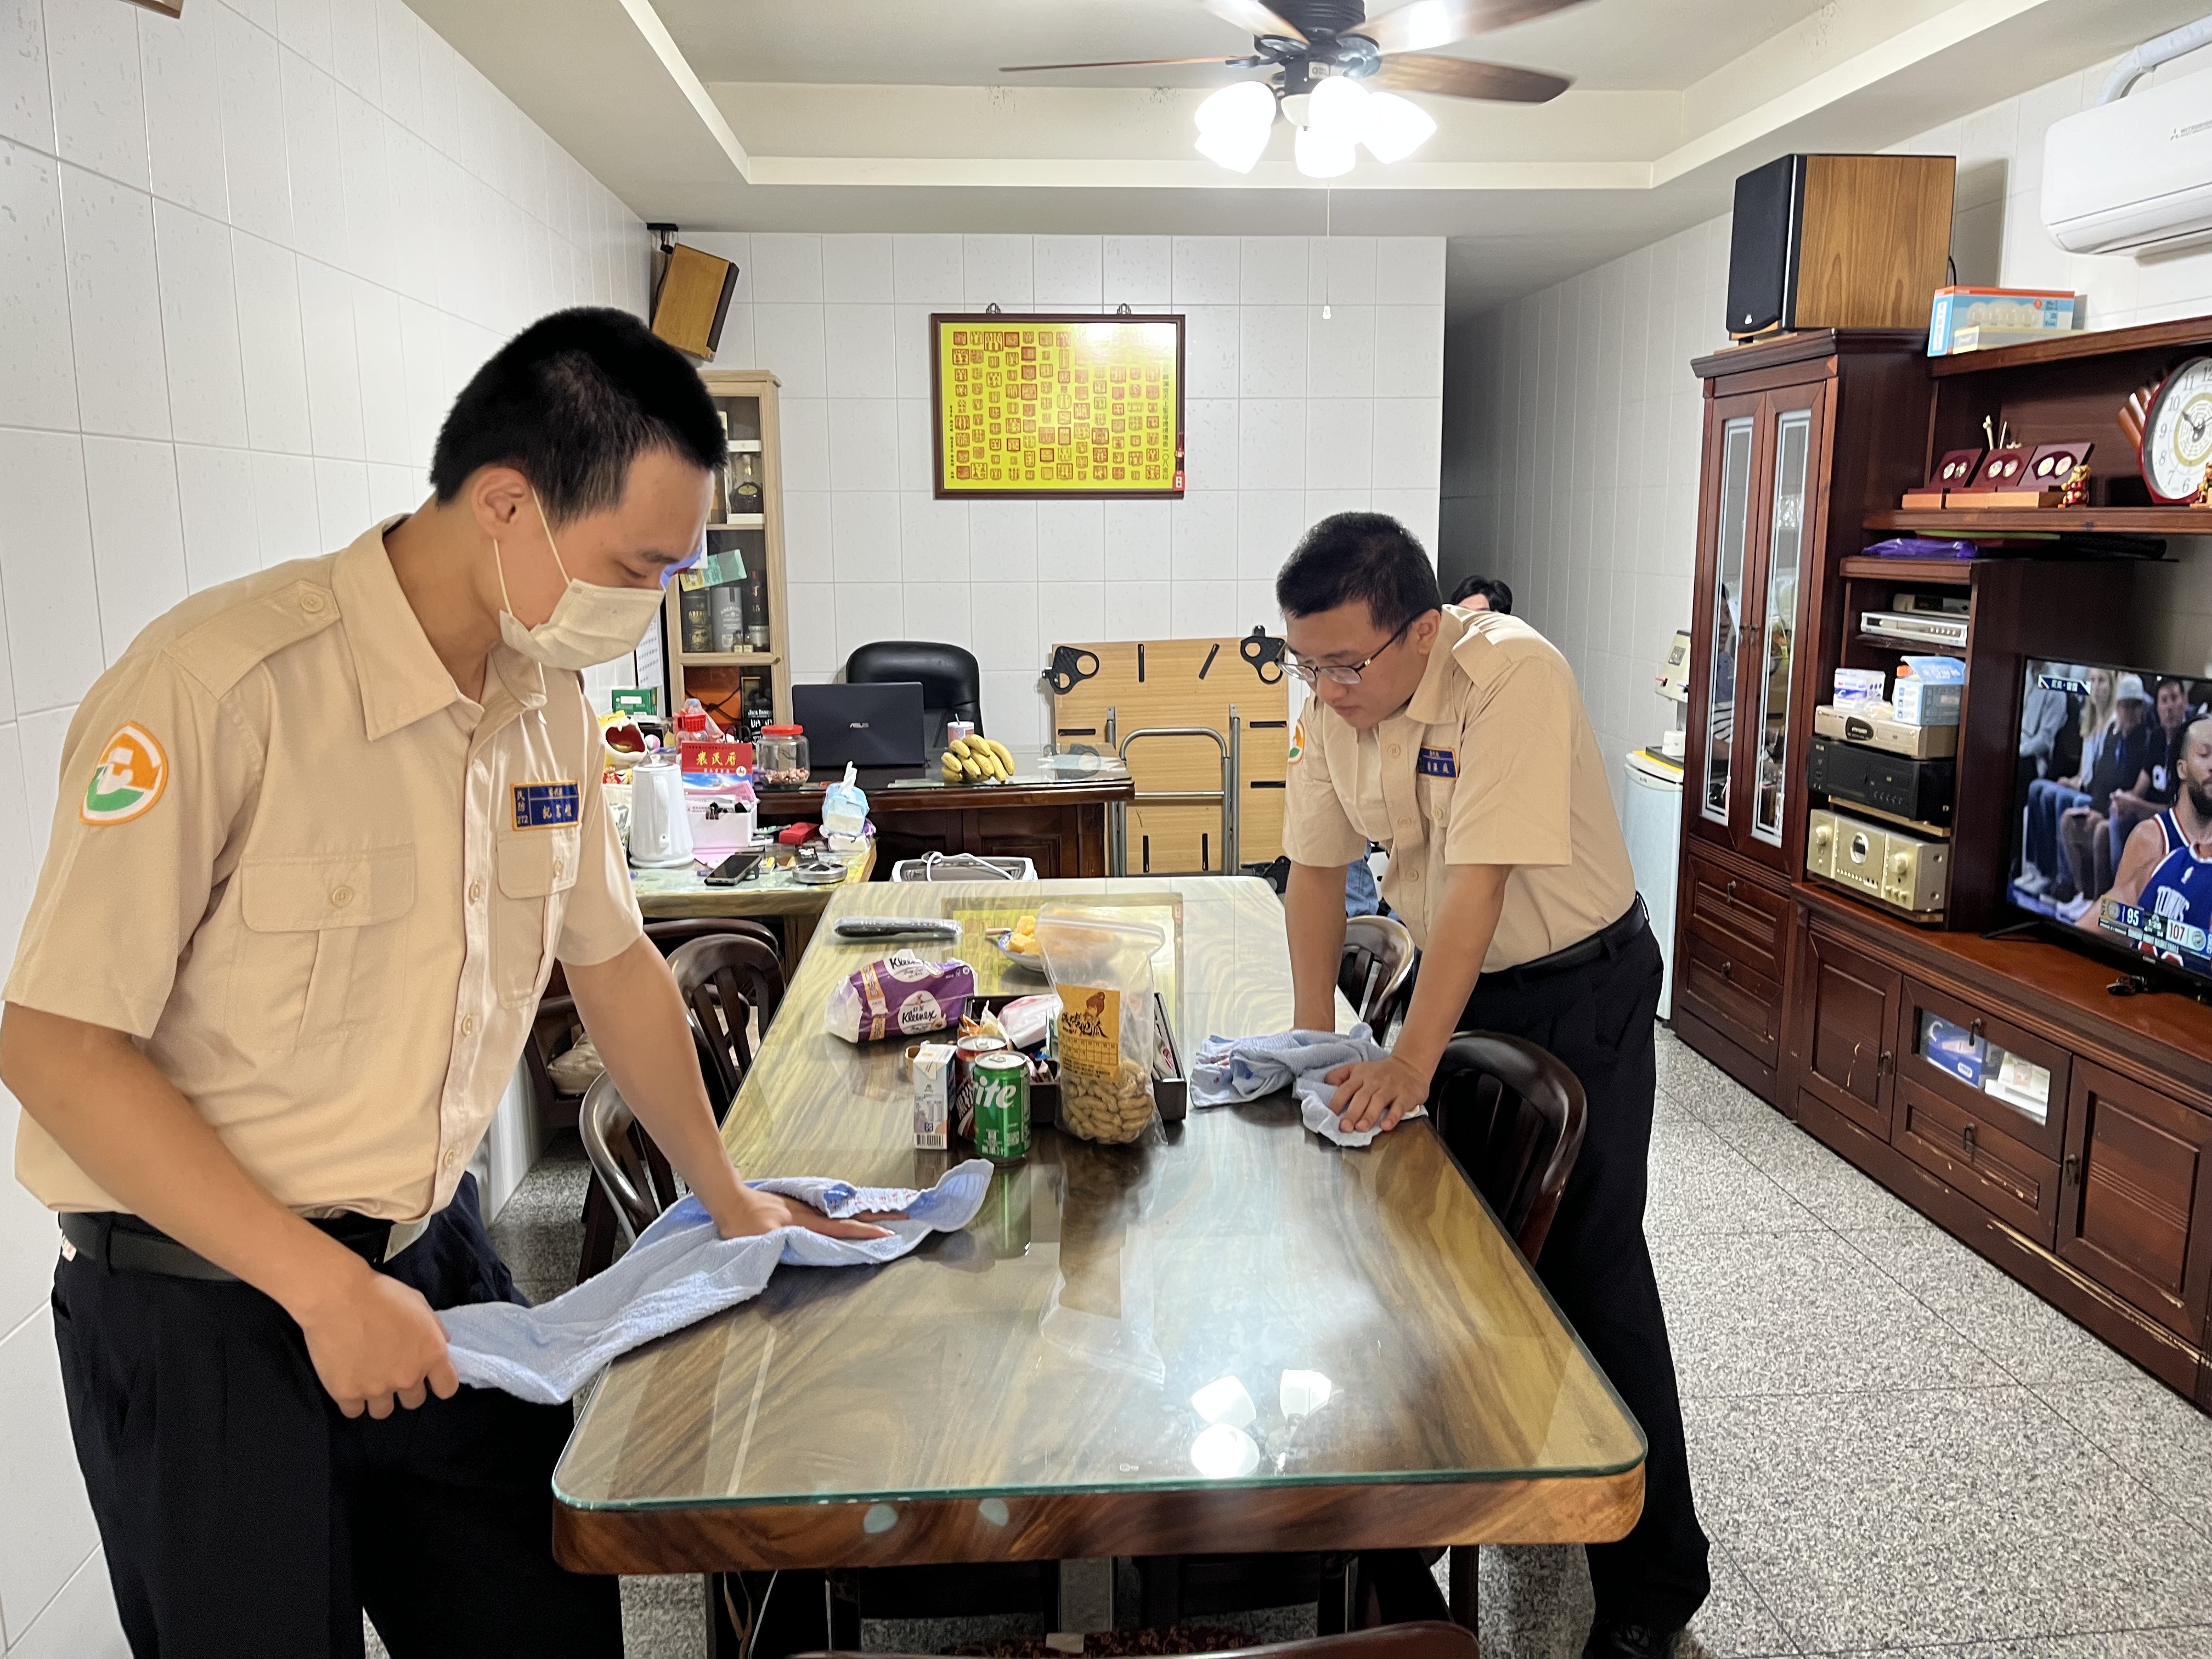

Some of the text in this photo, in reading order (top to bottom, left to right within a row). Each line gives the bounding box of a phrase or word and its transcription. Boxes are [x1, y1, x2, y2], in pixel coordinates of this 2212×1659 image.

[2183, 371, 2194, 391] 11
[2168, 395, 2180, 411] 10
[2159, 423, 2167, 438] 9
[2159, 450, 2166, 466] 8
[2168, 470, 2174, 486] 7
[2182, 478, 2190, 493] 6
[2127, 908, 2139, 927] 95
[2170, 922, 2186, 942] 107
[902, 1009, 936, 1024] Kleenex
[974, 1075, 1016, 1109] rite
